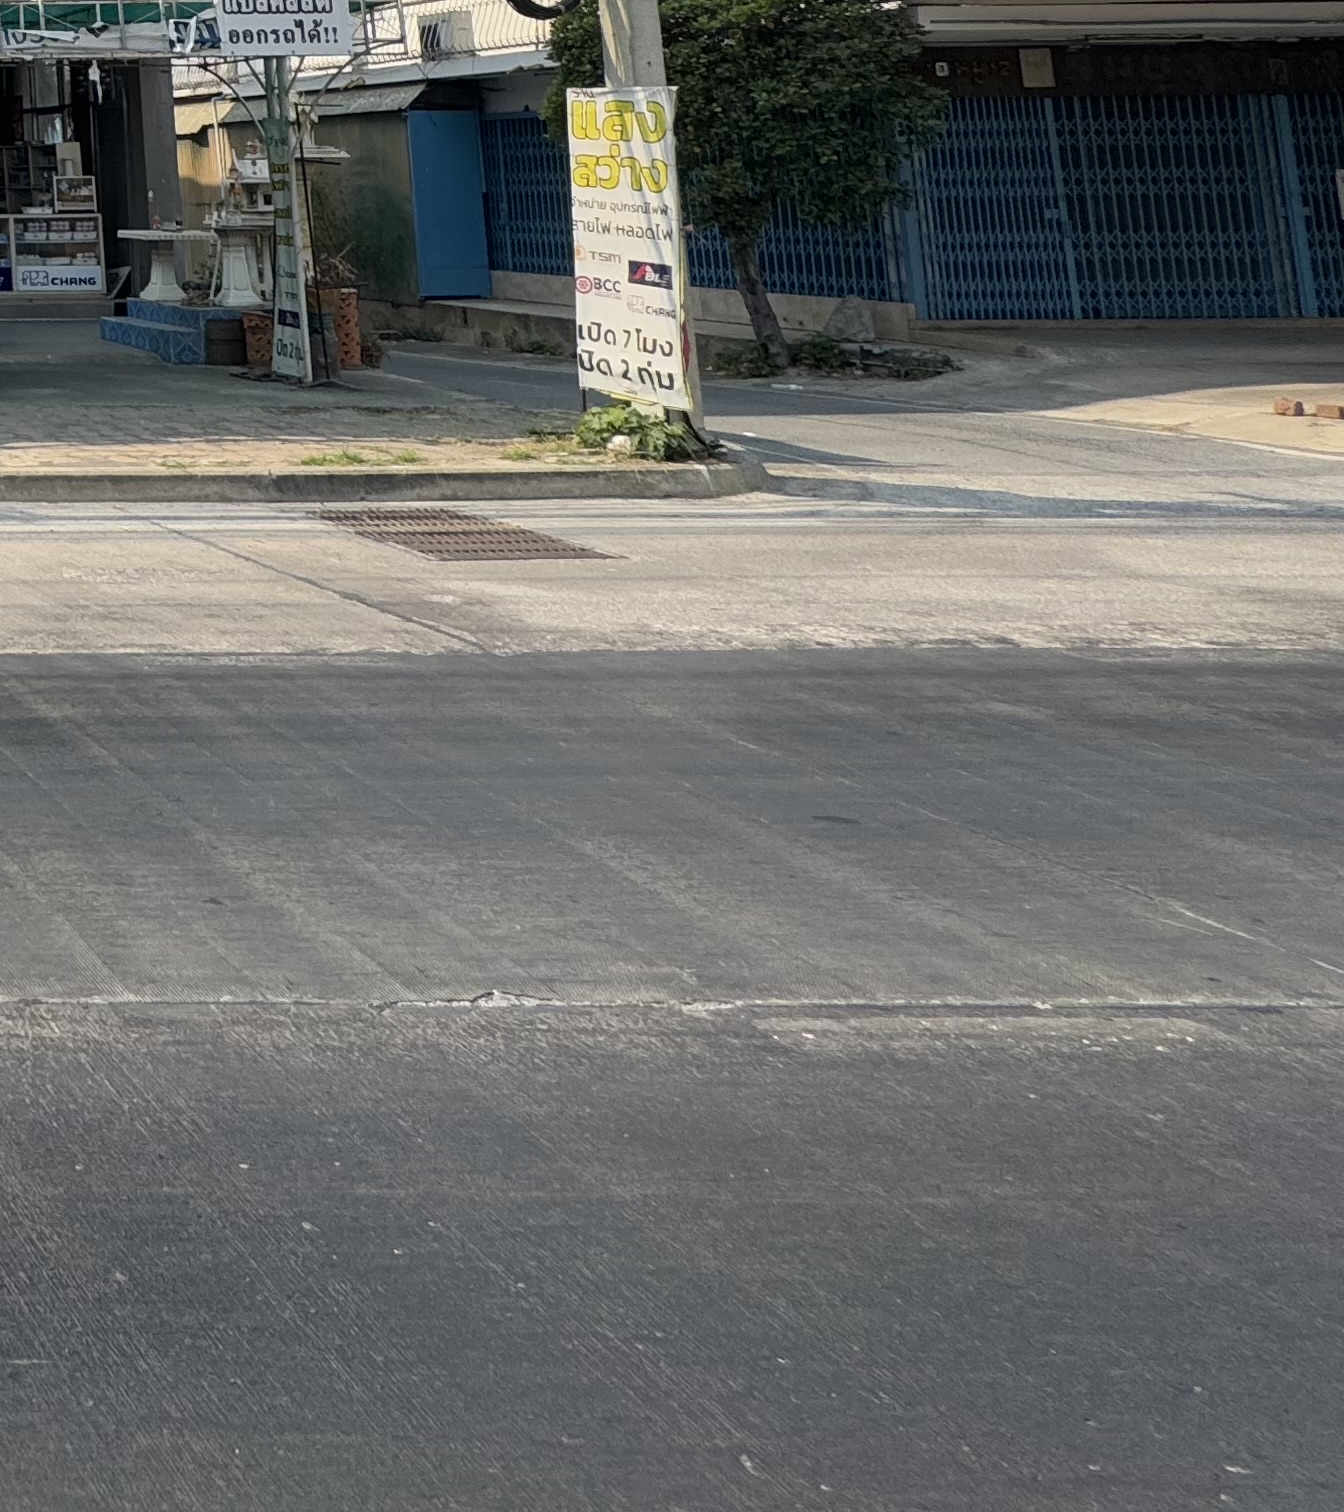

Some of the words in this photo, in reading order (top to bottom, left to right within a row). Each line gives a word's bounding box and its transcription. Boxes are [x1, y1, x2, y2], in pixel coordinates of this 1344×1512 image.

[228, 20, 339, 45] ออกรถได้!!
[571, 100, 667, 144] แสง
[573, 143, 668, 194] สว่าง
[615, 223, 673, 242] หลอดไฟ
[50, 277, 97, 287] CHANG
[592, 277, 622, 293] BCC
[645, 305, 677, 320] CHANG
[578, 321, 617, 346] เปิด
[622, 329, 632, 348] 7
[634, 328, 674, 358] โมง
[578, 349, 614, 378] ปิด
[620, 359, 633, 382] 2
[637, 360, 675, 395] ทุ่ม
